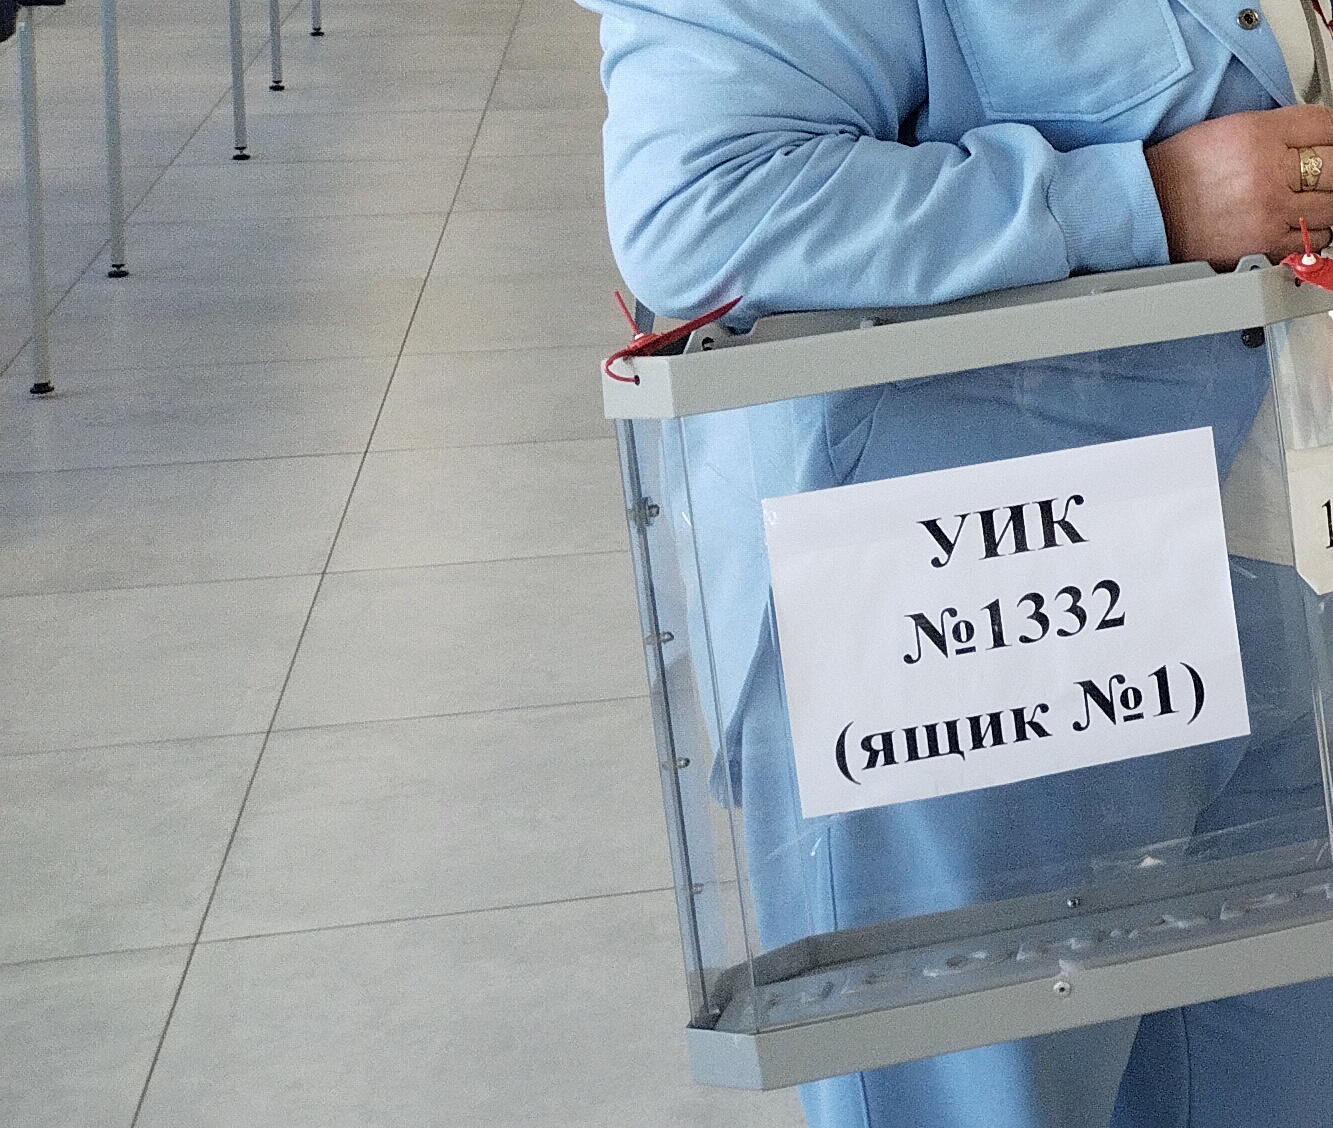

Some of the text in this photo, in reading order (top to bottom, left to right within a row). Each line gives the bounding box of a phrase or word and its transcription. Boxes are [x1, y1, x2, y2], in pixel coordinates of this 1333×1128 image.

[918, 494, 1089, 568] УИК
[903, 579, 1126, 664] №1332
[835, 662, 1206, 784] (ящик №1)
